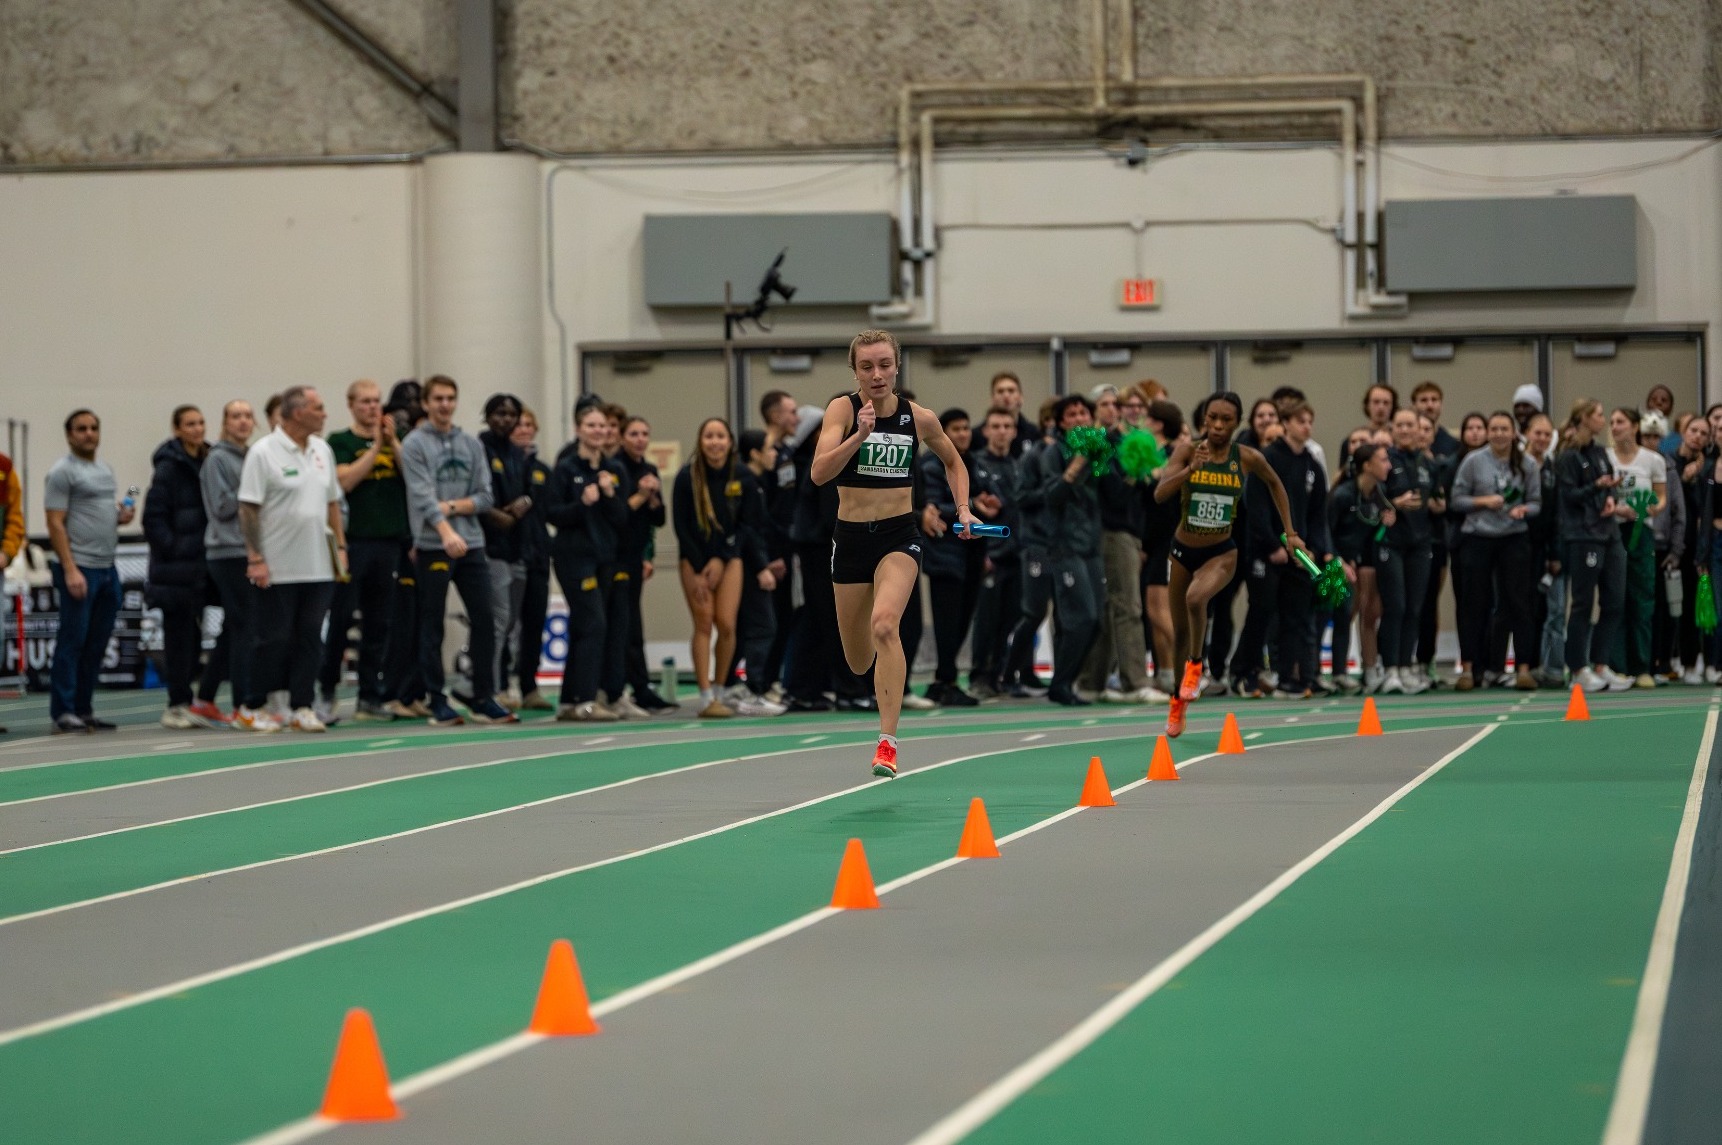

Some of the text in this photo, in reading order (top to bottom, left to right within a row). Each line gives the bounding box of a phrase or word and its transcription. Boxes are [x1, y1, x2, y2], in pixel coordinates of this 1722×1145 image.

[1124, 279, 1155, 304] EXIT
[866, 443, 909, 467] 1207
[1190, 469, 1242, 488] REGINA
[1197, 501, 1225, 521] 855
